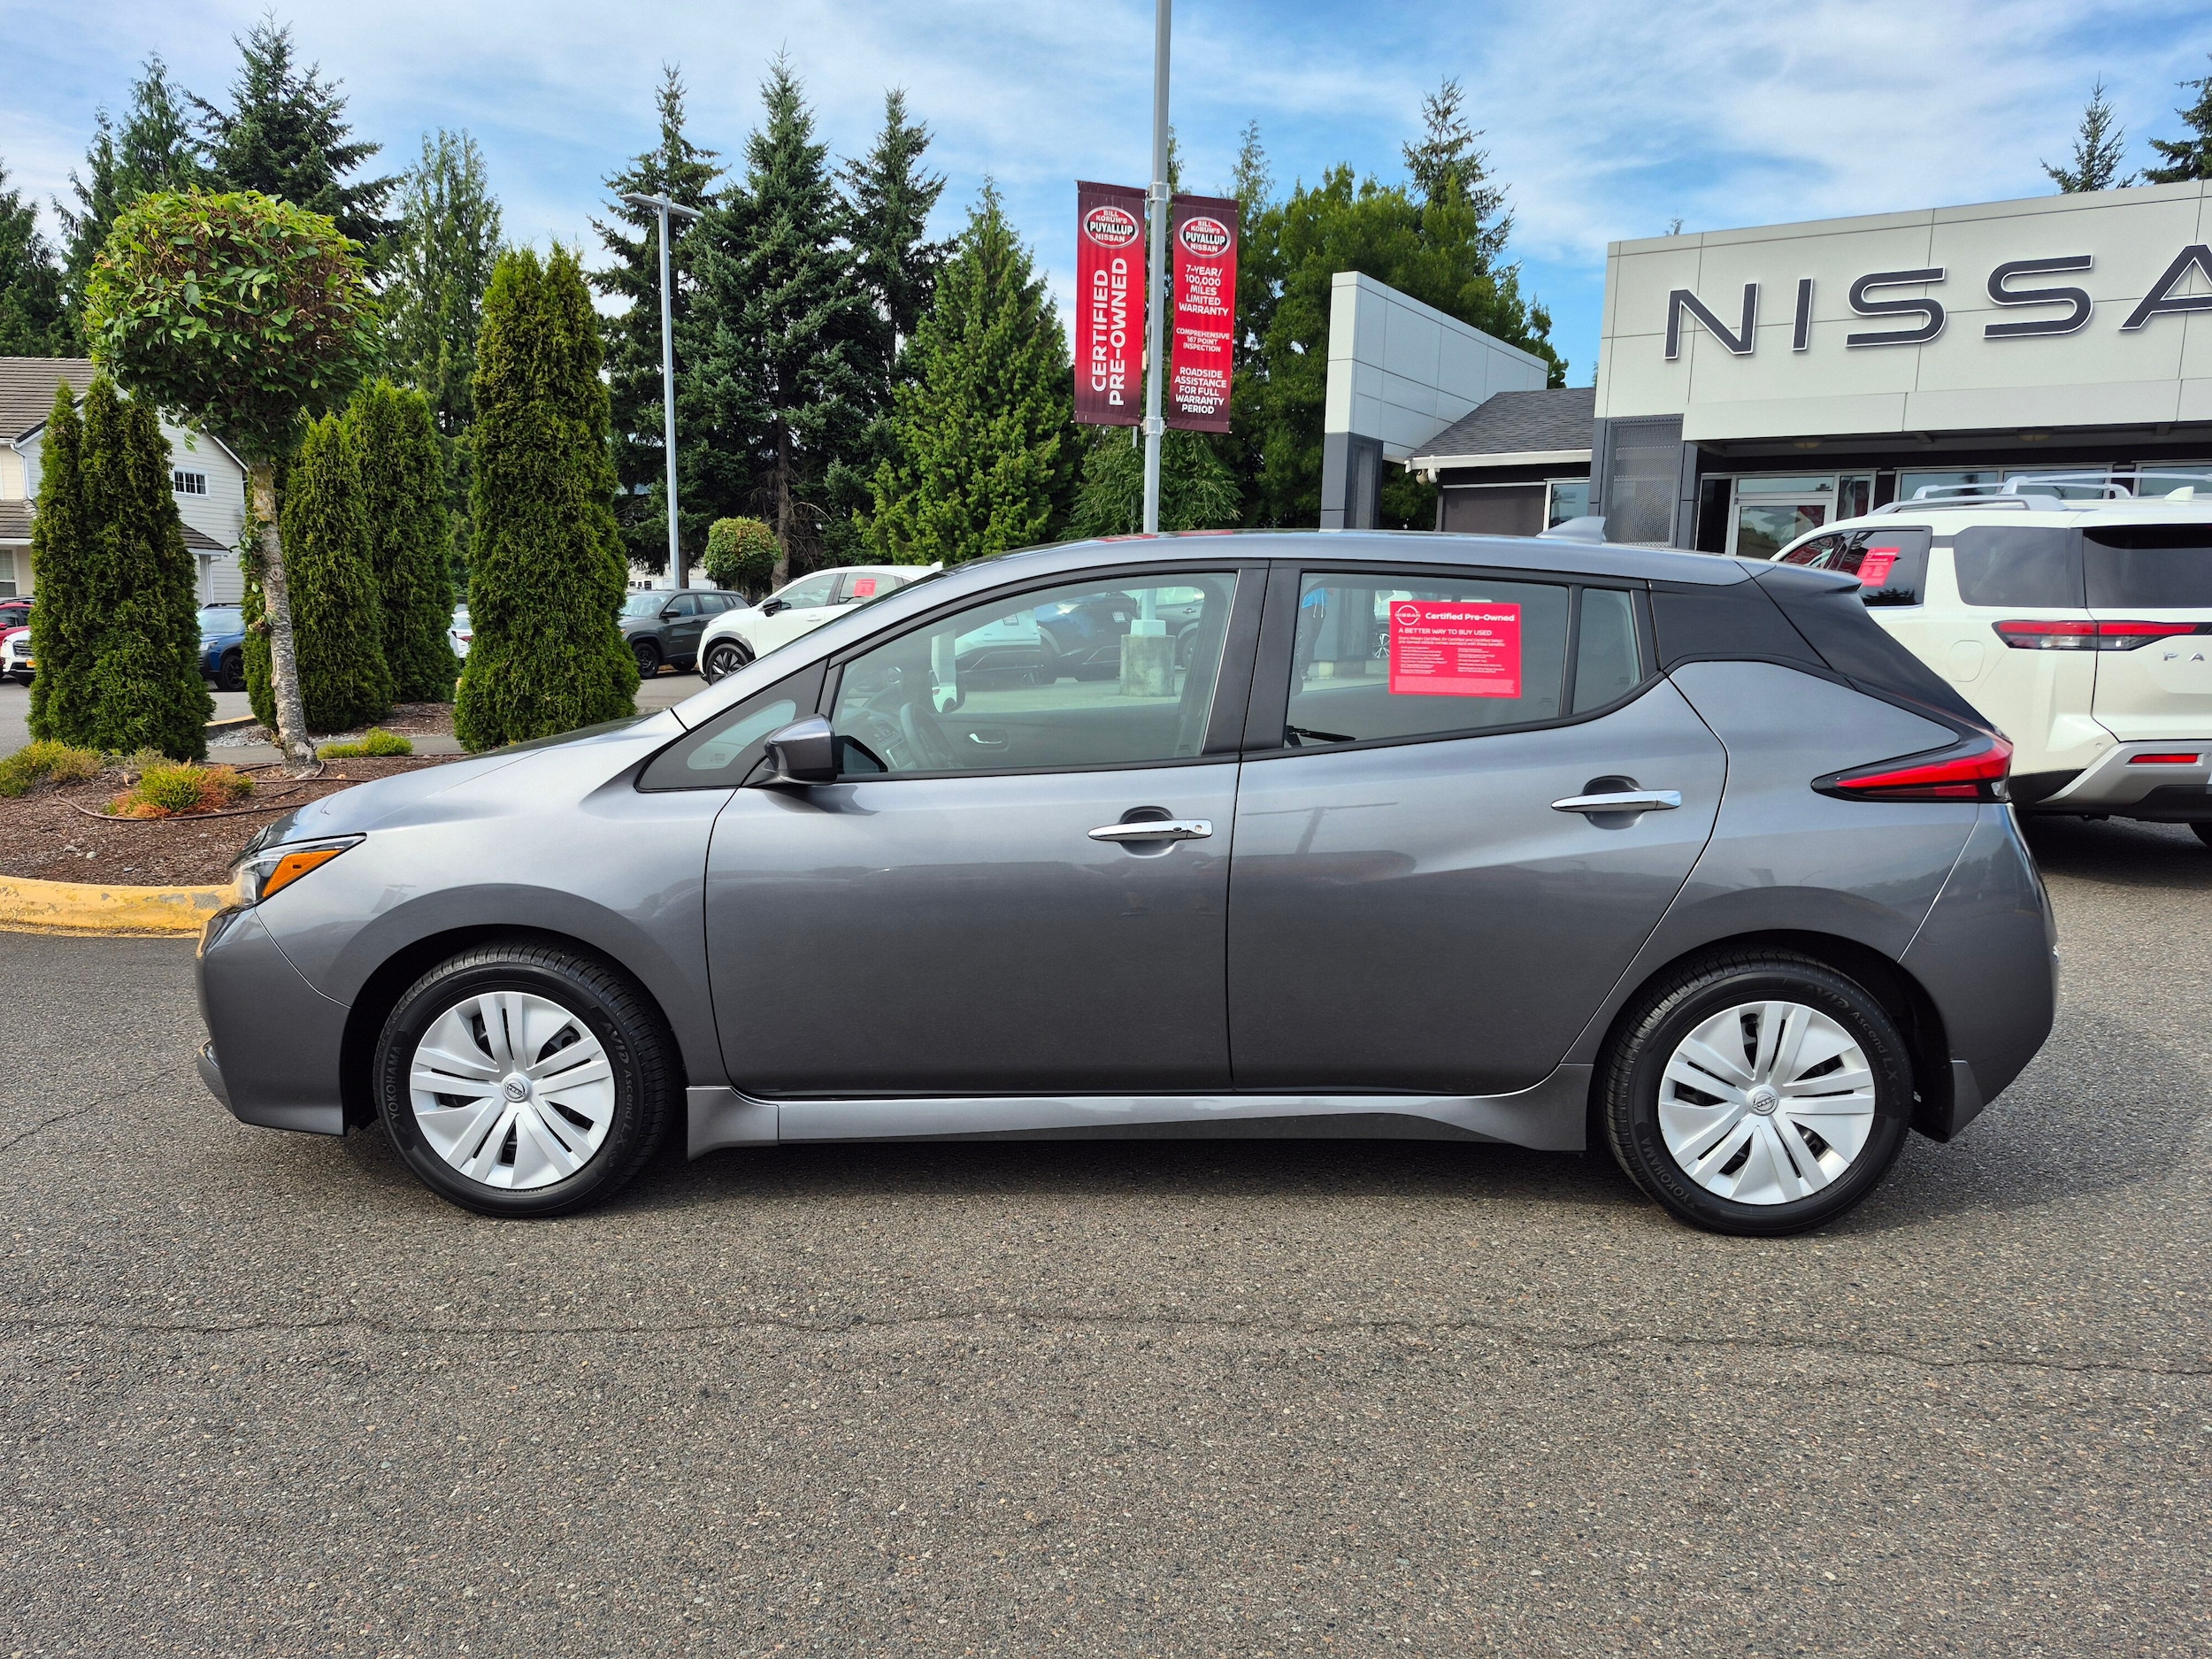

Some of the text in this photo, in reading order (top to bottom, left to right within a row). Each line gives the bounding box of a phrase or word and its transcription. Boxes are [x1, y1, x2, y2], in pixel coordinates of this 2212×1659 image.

[1095, 215, 1127, 224] KORUM'S
[1089, 221, 1133, 235] PUYALLUP
[1190, 226, 1220, 234] KORUM'S
[1095, 233, 1125, 242] NISSAN
[1186, 232, 1225, 246] PUYALLUP
[1190, 242, 1218, 252] NISSAN
[1186, 265, 1223, 278] 7-YEAR/
[1185, 274, 1221, 287] 100,000
[1190, 285, 1217, 296] MILES
[1186, 294, 1221, 306] LIMITED
[1179, 302, 1229, 317] WARRANTY
[1091, 269, 1109, 392] CERTIFIED
[1109, 257, 1127, 406] PRE-OWNED
[1176, 327, 1230, 340] COMPREHENSIVE
[1183, 342, 1221, 353] INSPECTION
[1179, 366, 1223, 379] ROADSIDE
[1174, 375, 1227, 388] ASSISTANCE
[1179, 385, 1219, 397] FOR FULL
[1175, 394, 1225, 406] WARRANTY
[1181, 403, 1215, 415] PERIOD
[1464, 613, 1515, 622] Pre-Owned
[2163, 651, 2205, 662] PA
[1849, 1011, 1888, 1054] Ascend
[1882, 1057, 1898, 1079] LX
[386, 1046, 403, 1120] YOKOHAMA
[623, 1069, 634, 1120] Ascend
[617, 1124, 632, 1148] LX
[1640, 1136, 1690, 1203] YOKOHAMA
